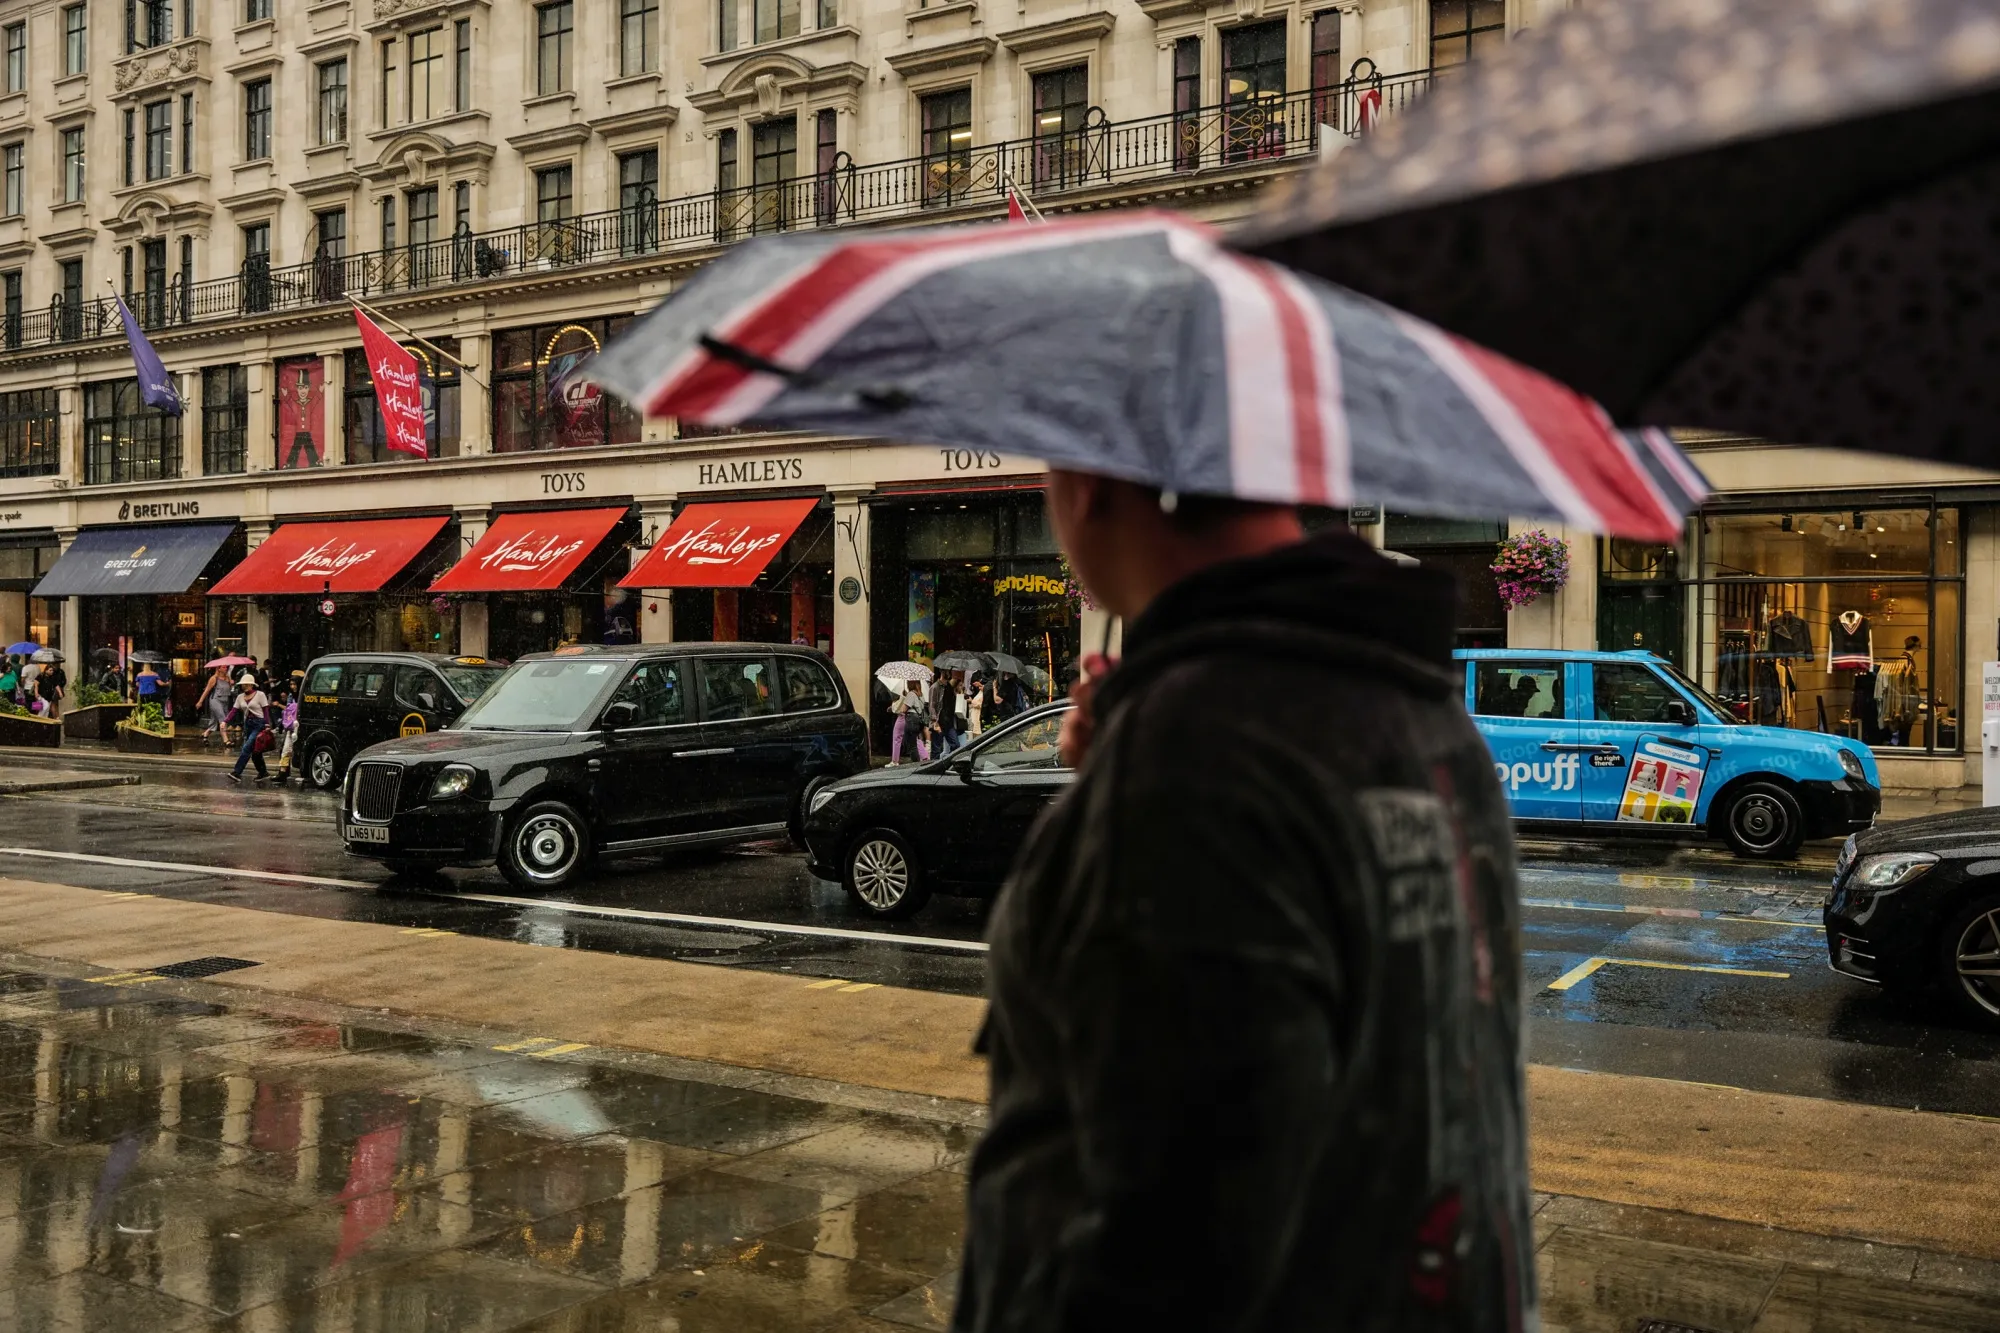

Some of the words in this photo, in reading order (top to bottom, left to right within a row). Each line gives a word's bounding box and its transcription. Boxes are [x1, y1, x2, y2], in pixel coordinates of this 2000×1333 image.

[376, 357, 417, 389] Hamleys
[940, 448, 1001, 471] TOYS
[541, 472, 586, 494] TOYS
[698, 458, 803, 485] HAMLEYS
[133, 501, 200, 519] BREITLING
[480, 530, 584, 572] Hamleys
[662, 519, 781, 566] Hamleys
[103, 558, 157, 569] BREITLING
[284, 536, 377, 577] Hamleys
[324, 603, 334, 611] 20
[1603, 755, 1621, 763] right
[1494, 753, 1580, 791] opuff
[349, 827, 369, 839] LN69
[370, 828, 386, 841] VJJ
